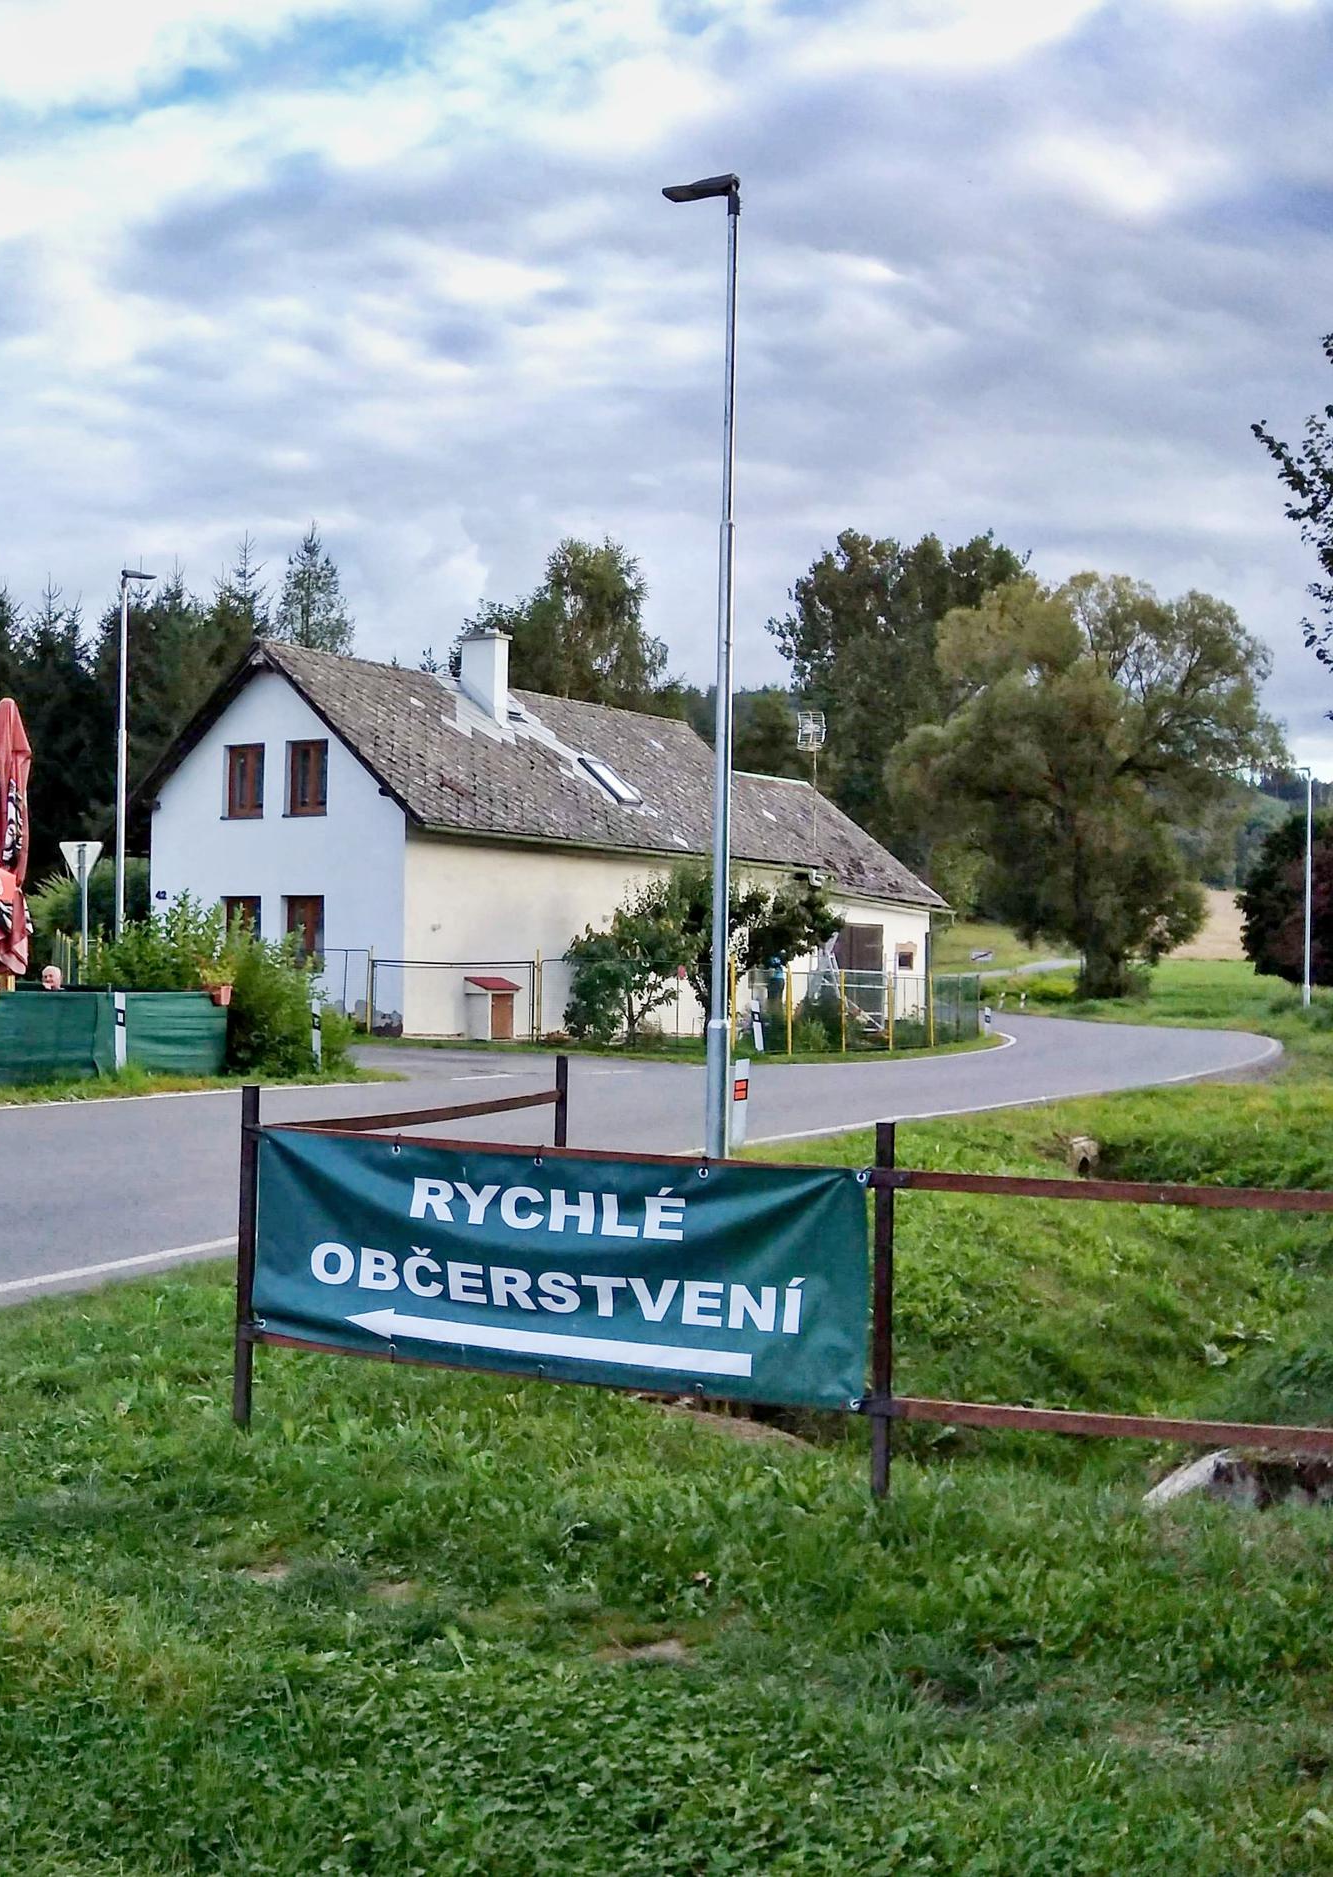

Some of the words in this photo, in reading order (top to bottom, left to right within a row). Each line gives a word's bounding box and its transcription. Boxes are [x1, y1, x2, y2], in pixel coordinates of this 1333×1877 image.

[155, 890, 167, 899] 42
[409, 1177, 686, 1241] RYCHLÉ
[310, 1241, 806, 1334] OBČERSTVENÍ
